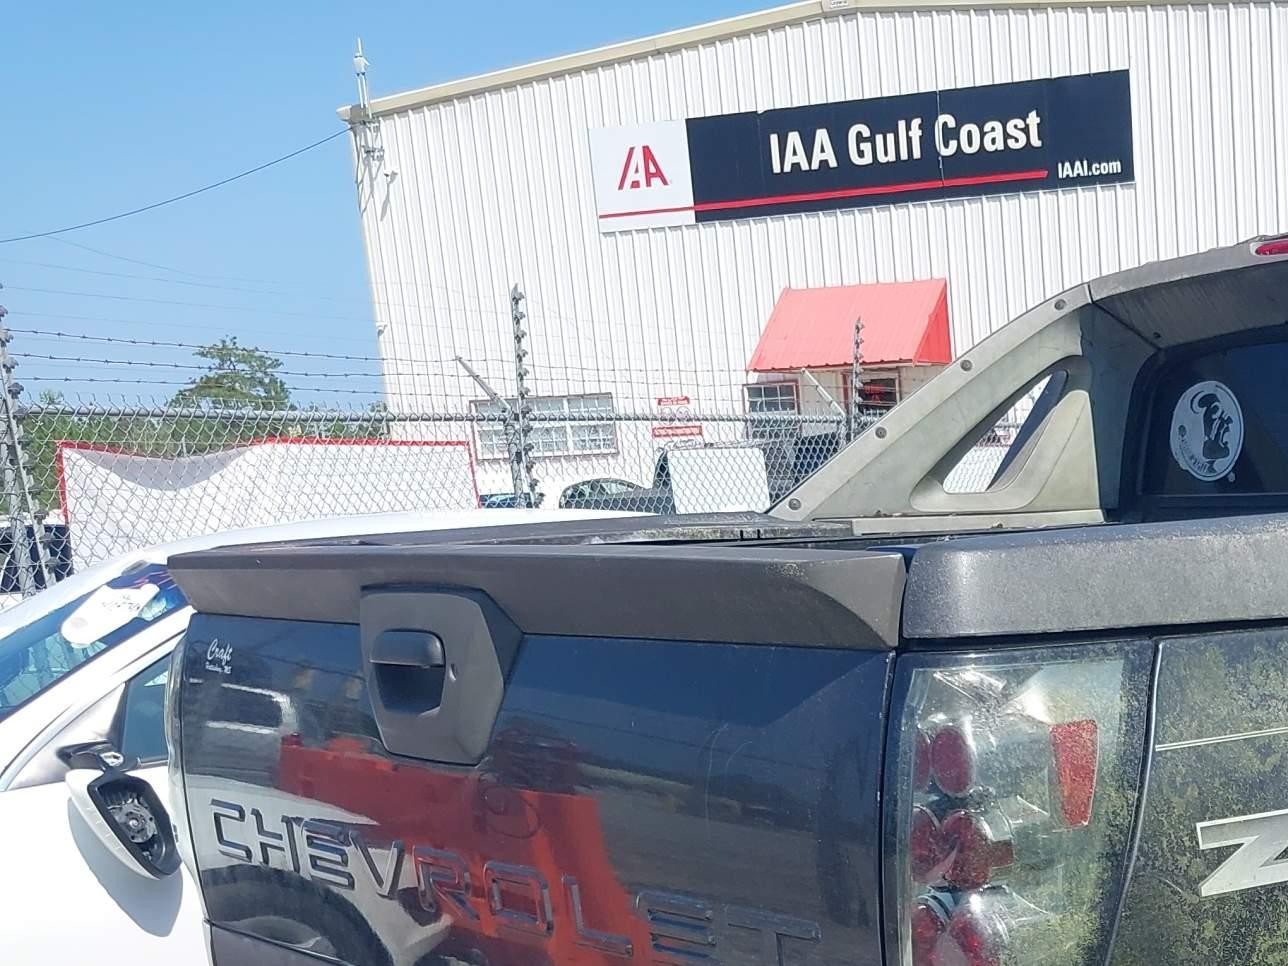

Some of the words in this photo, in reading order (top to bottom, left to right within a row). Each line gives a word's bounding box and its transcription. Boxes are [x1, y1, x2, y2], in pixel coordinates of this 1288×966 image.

[769, 128, 838, 174] IAA
[847, 117, 924, 166] Gulf
[934, 109, 1043, 157] Coast
[1057, 159, 1122, 179] IAAI.com
